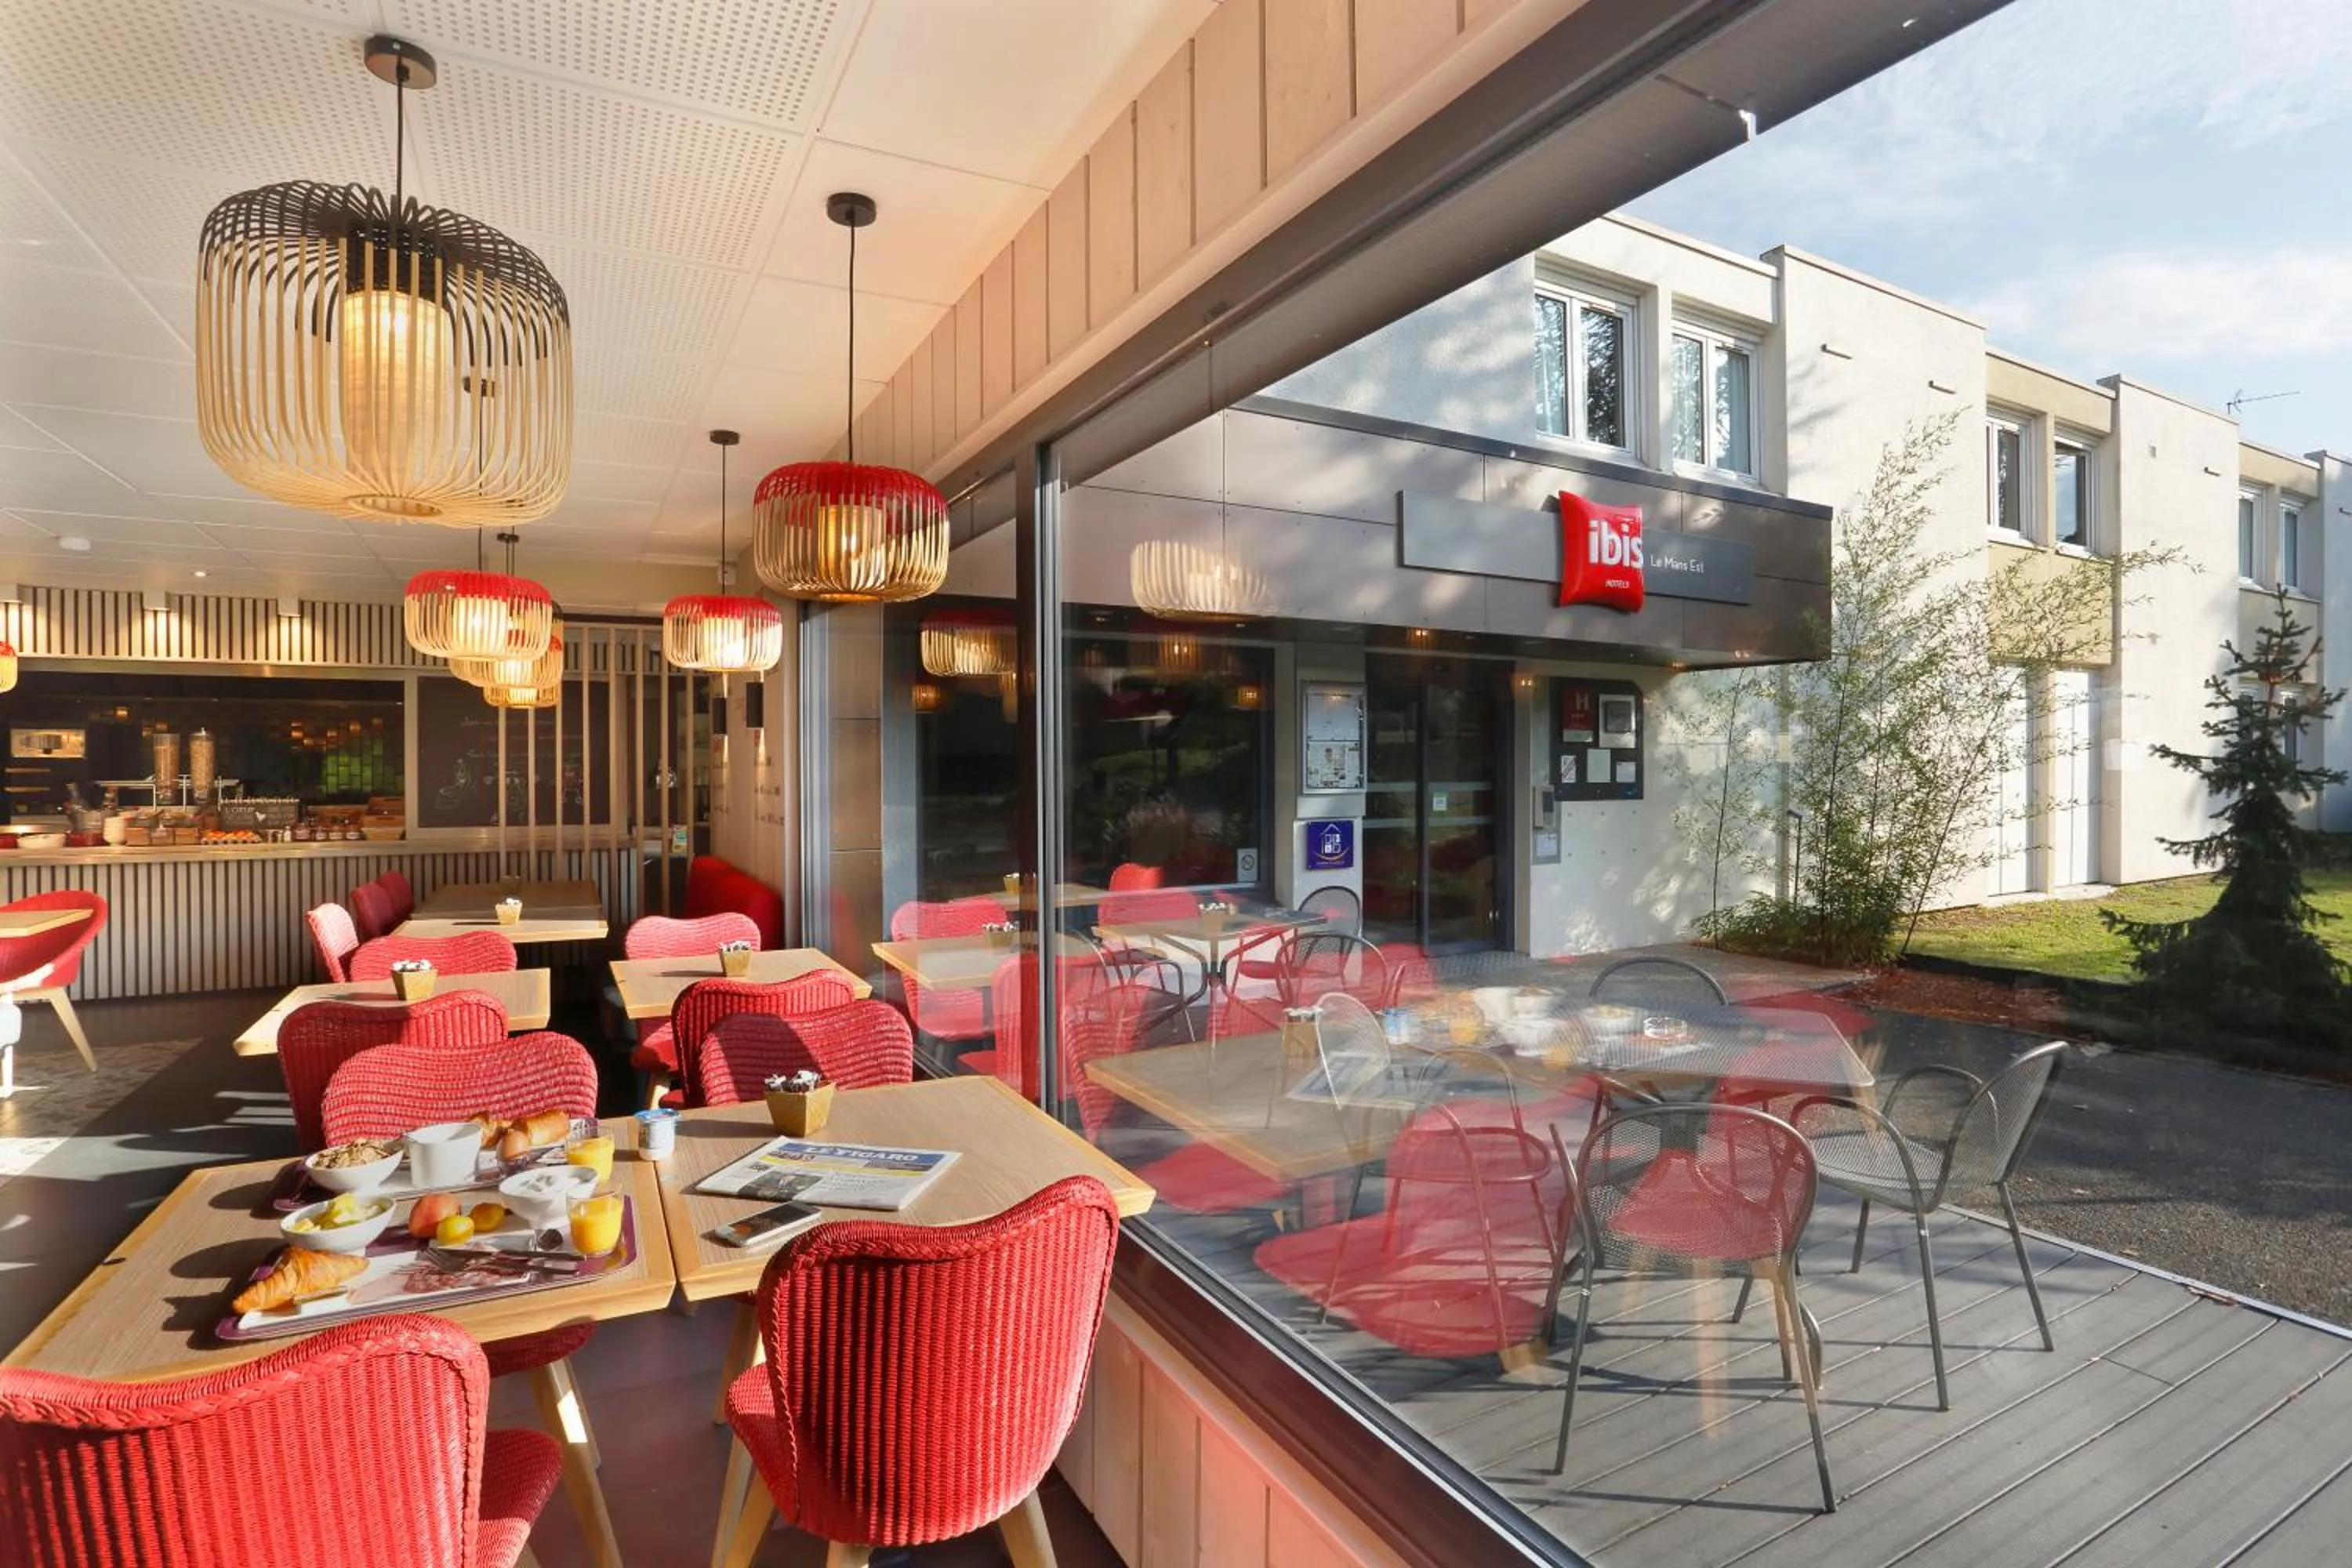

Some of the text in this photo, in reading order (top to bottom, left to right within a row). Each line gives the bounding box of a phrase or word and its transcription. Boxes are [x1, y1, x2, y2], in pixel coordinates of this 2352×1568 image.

[1588, 519, 1644, 569] ibis
[1650, 554, 1704, 574] Le Mans Est
[834, 1148, 919, 1162] FIGARO
